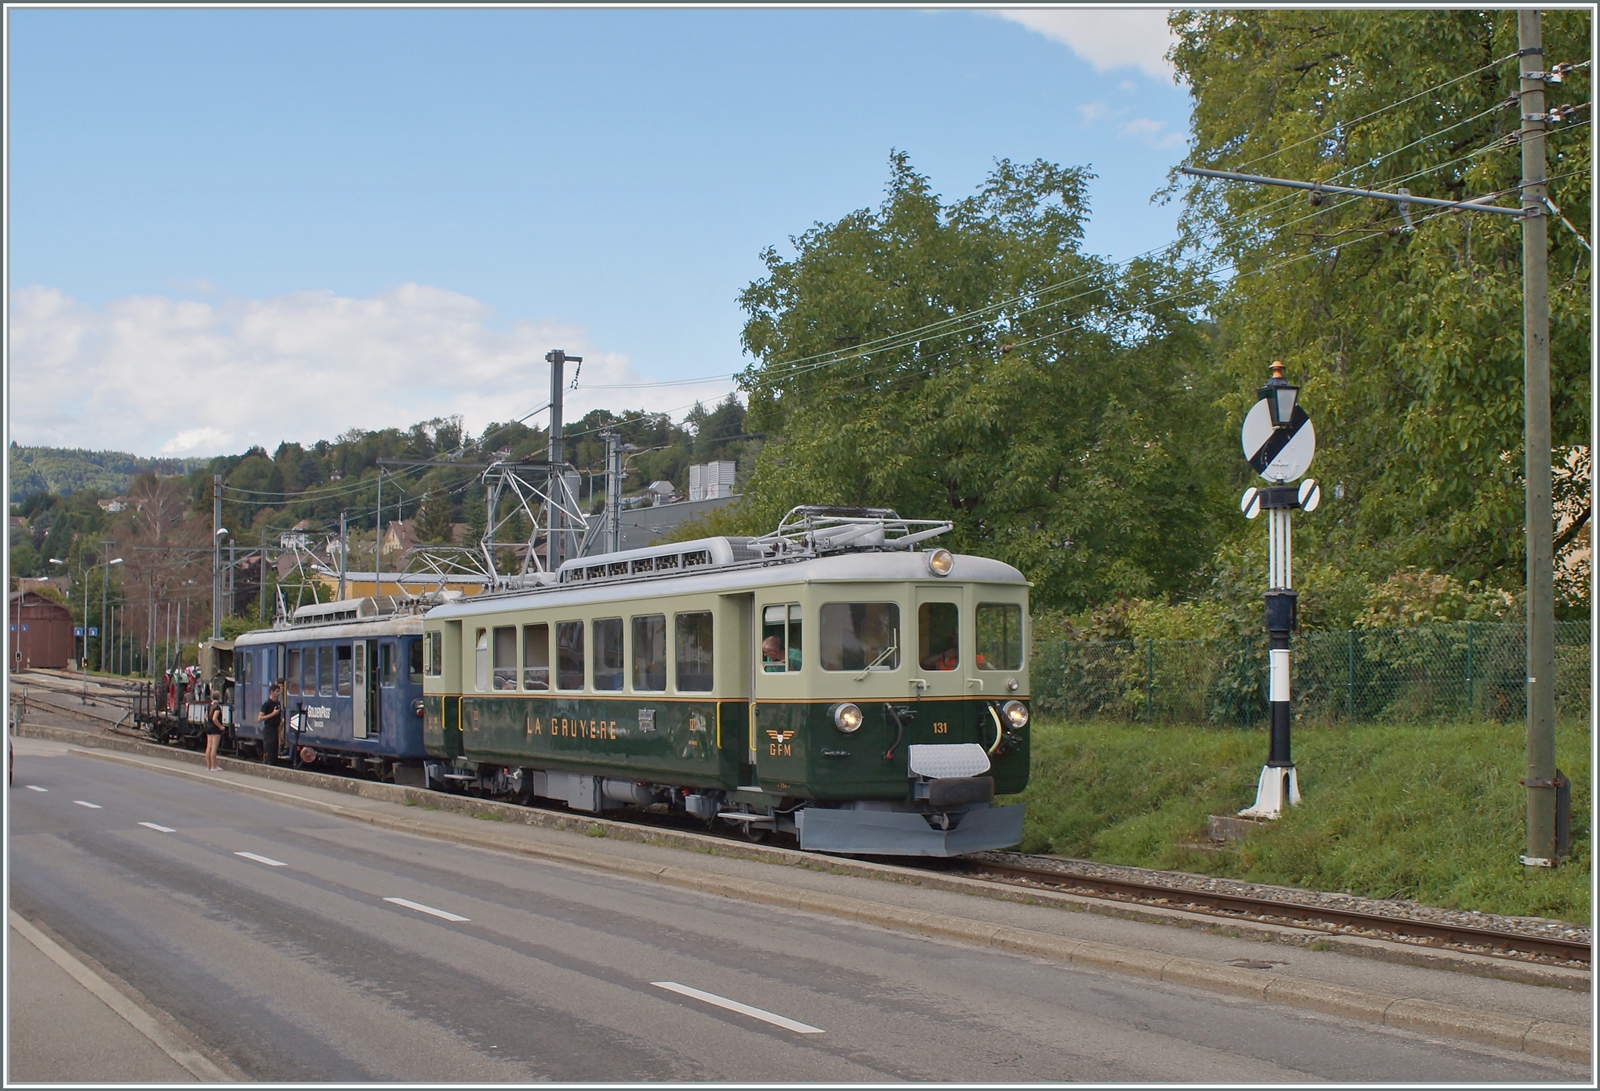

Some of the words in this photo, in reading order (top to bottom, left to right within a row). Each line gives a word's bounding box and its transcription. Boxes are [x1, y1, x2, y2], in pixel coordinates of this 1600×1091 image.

[526, 717, 542, 735] LA
[551, 717, 617, 740] GRUYÈRE
[933, 722, 948, 734] 131
[769, 743, 791, 757] GFM
